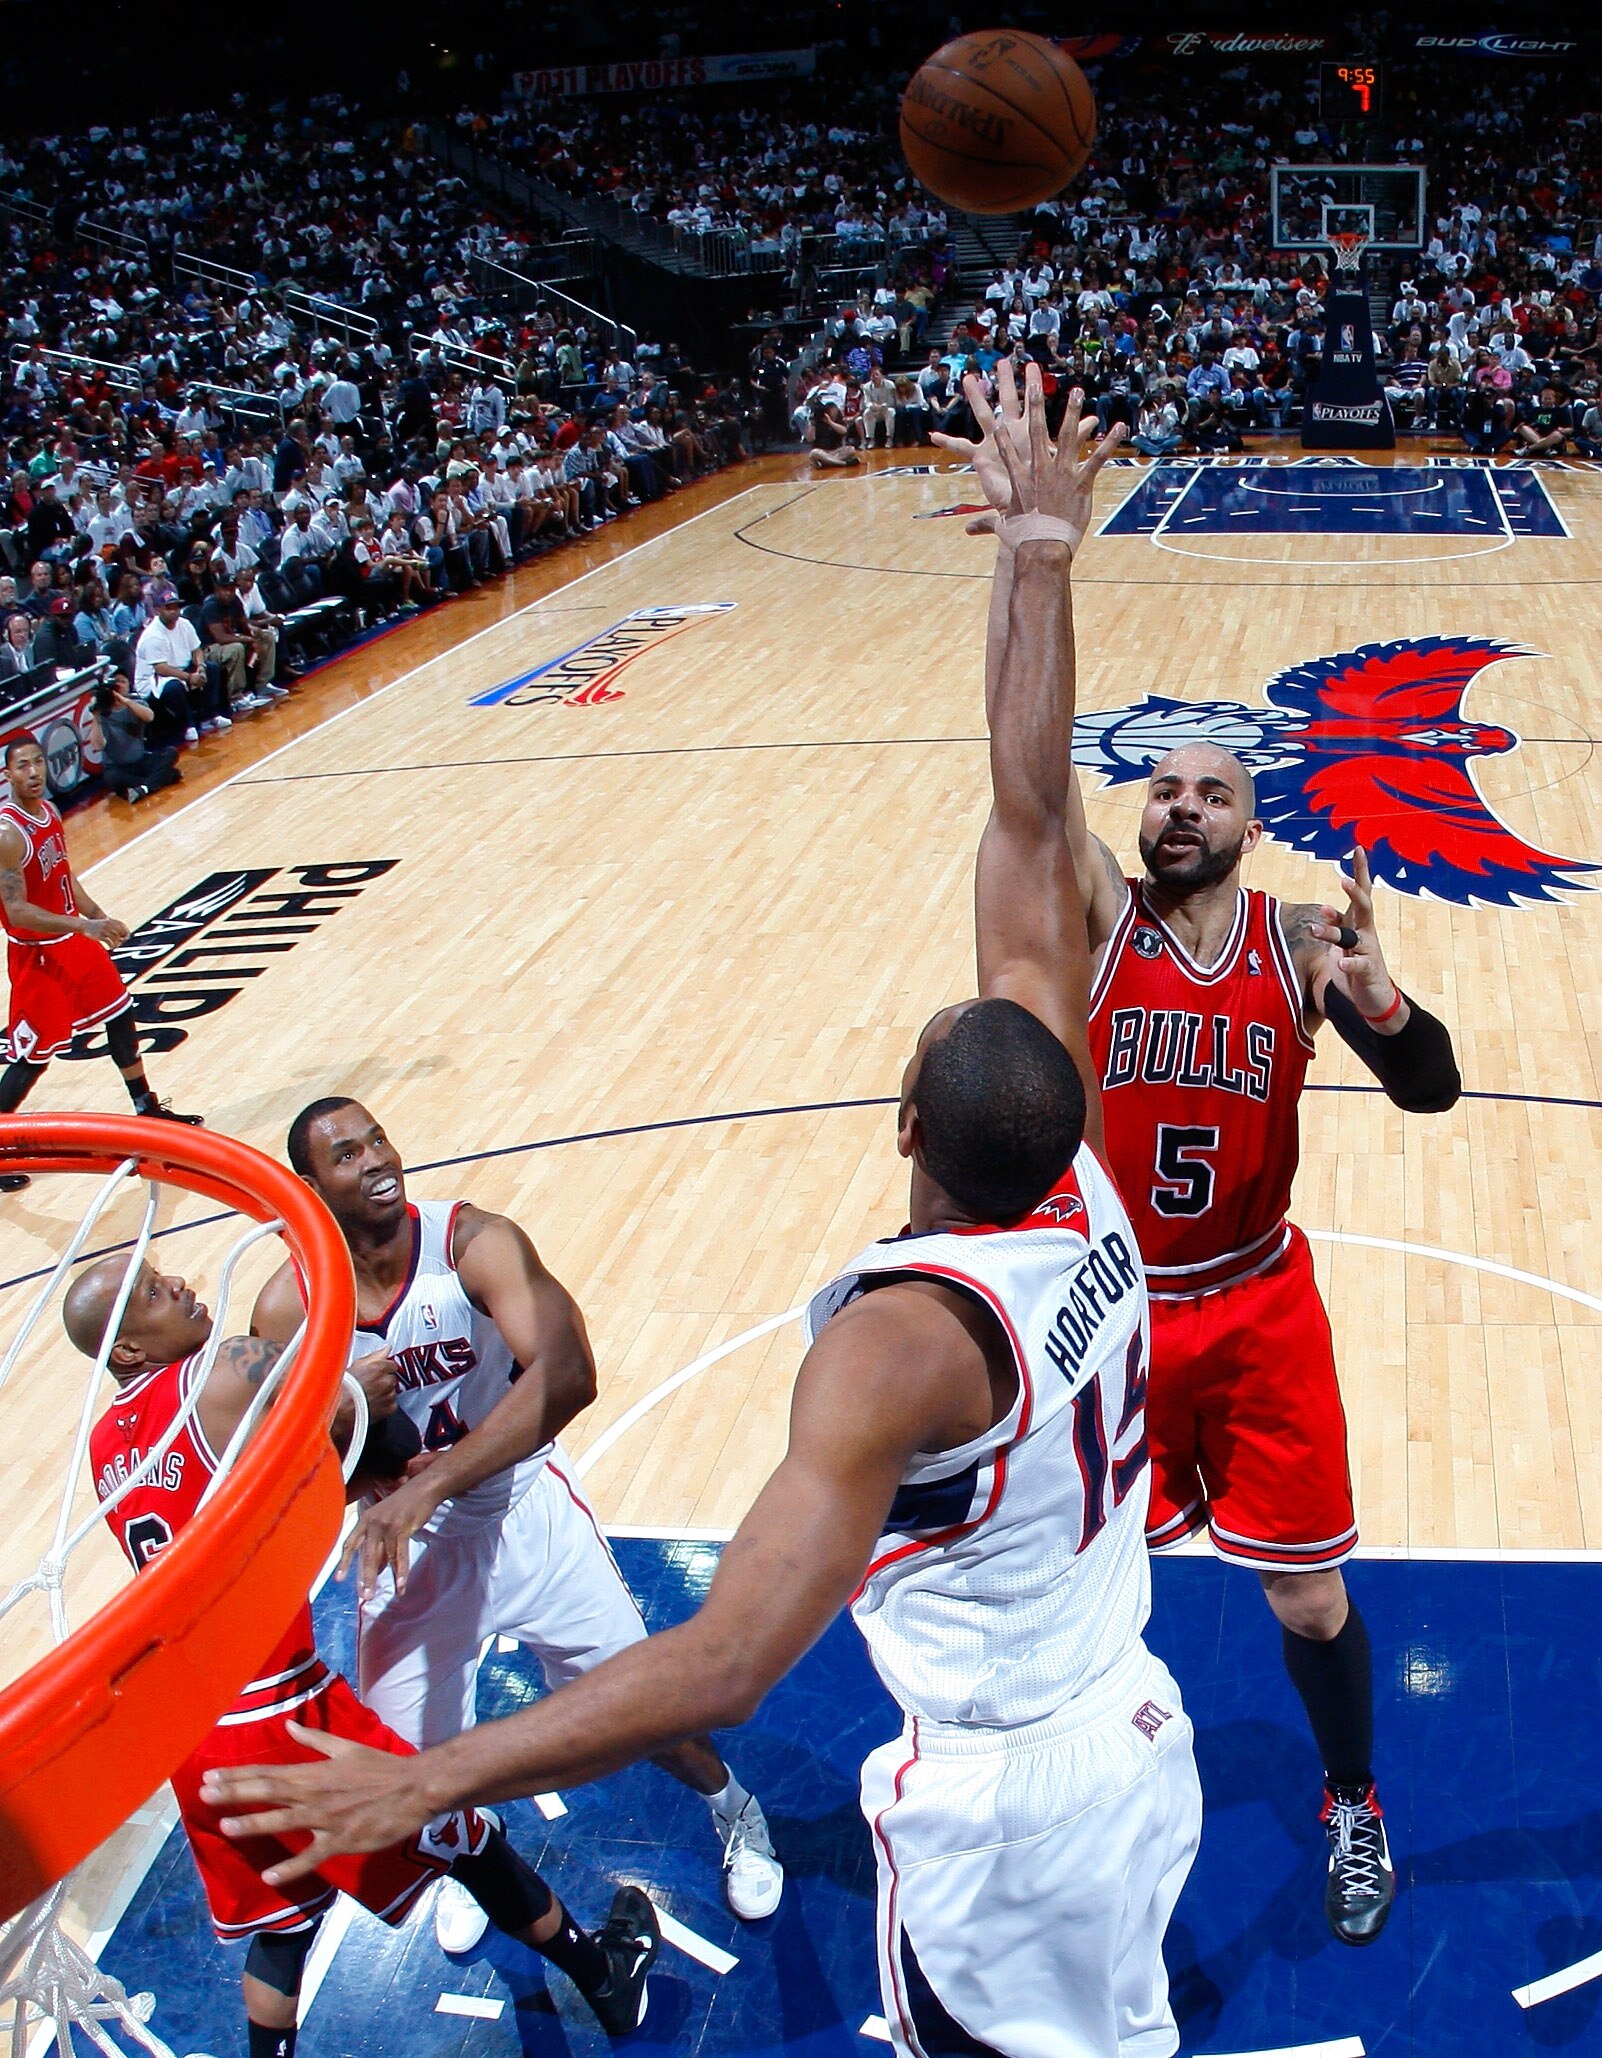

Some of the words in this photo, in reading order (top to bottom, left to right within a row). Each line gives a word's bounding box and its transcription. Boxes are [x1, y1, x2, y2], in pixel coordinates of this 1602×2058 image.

[1415, 36, 1478, 47] BUD
[1493, 38, 1579, 51] LIGHT
[586, 59, 707, 91] PLAYOFFS
[1337, 67, 1375, 84] 9:55
[1350, 84, 1372, 112] 7
[1321, 407, 1381, 419] PLAYOFFS
[504, 617, 686, 707] PLAYOFFS
[61, 874, 75, 914] 1
[56, 859, 402, 1060] PHILIPS
[1103, 1007, 1275, 1103] BULLS
[1151, 1123, 1221, 1218] 5
[1045, 1231, 1139, 1384] HORFOR
[1131, 1700, 1173, 1742] ATL
